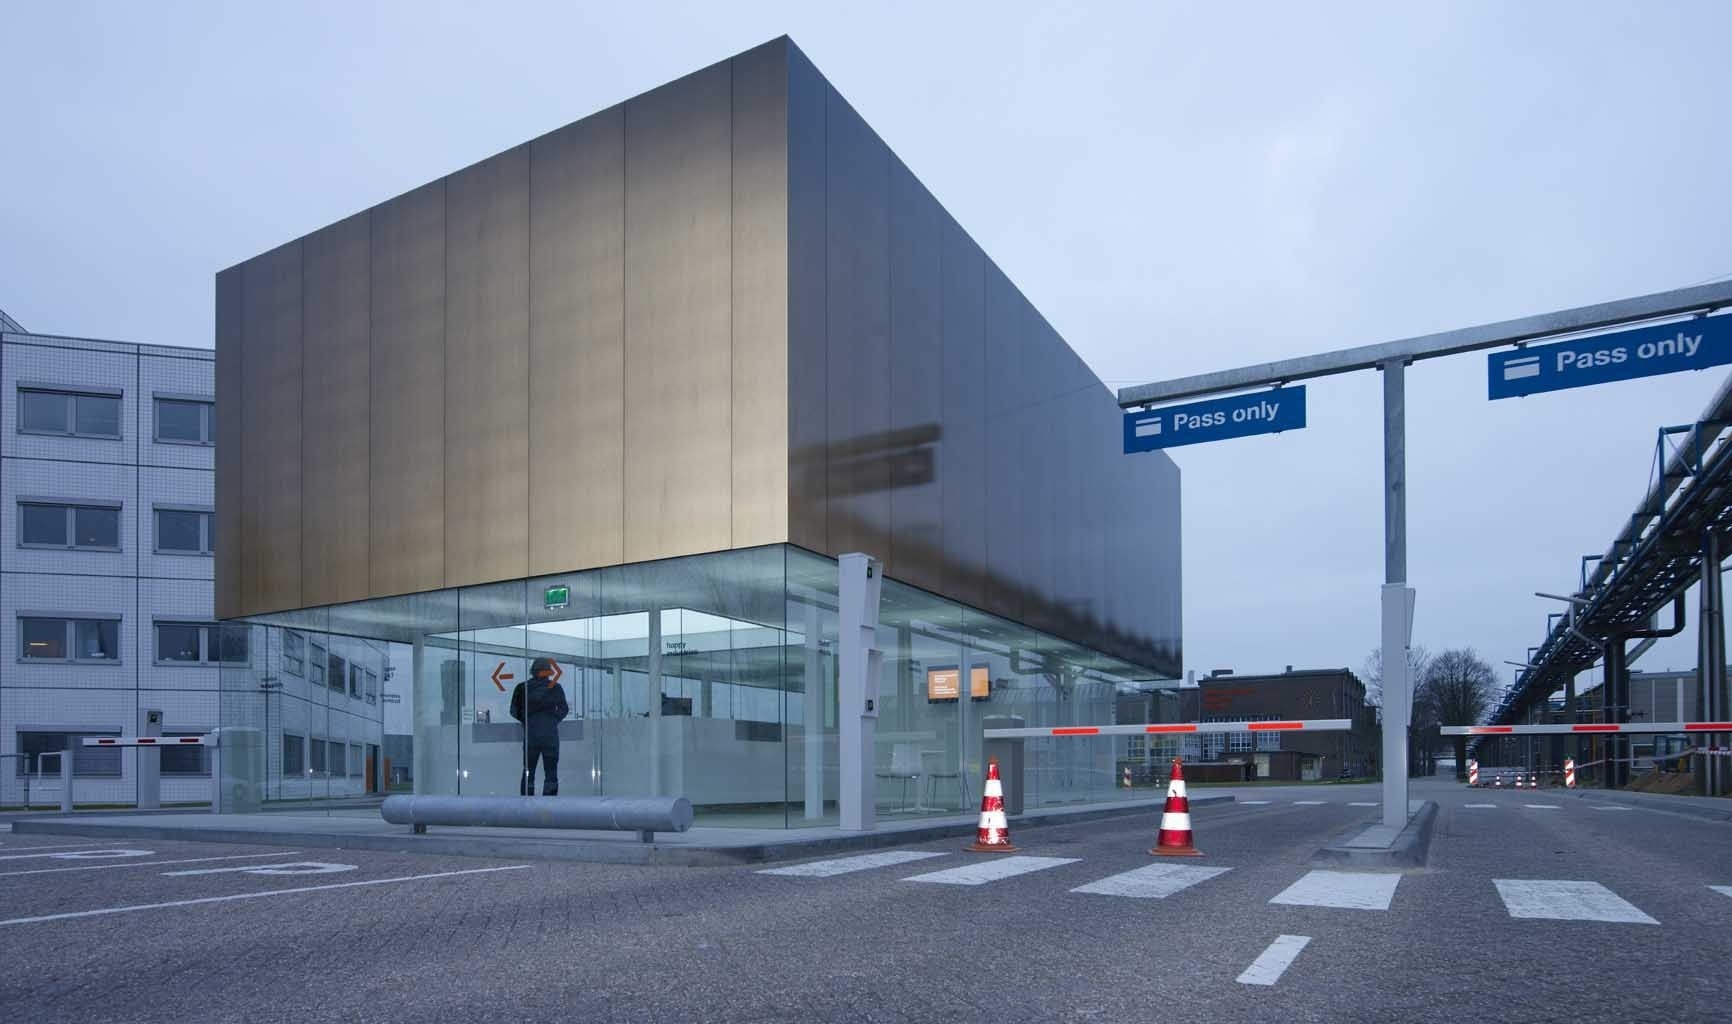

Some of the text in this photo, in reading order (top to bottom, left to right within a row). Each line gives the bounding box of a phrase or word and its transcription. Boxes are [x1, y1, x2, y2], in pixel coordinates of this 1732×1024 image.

[1556, 337, 1703, 372] Pass only
[1174, 401, 1280, 432] Pass only
